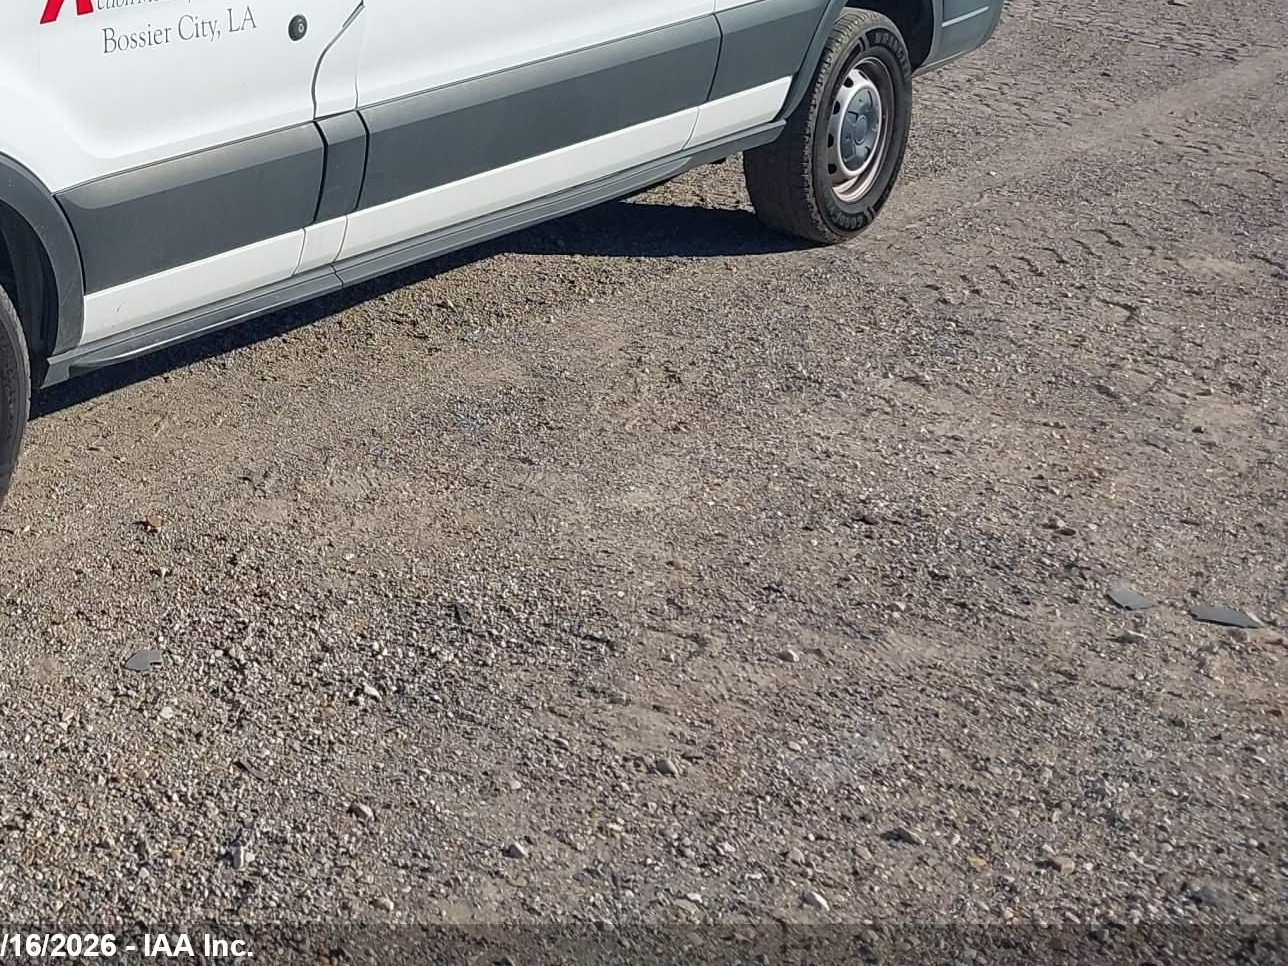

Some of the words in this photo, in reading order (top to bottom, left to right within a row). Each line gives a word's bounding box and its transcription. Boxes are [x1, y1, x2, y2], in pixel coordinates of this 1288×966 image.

[102, 23, 173, 54] Bossier
[178, 14, 222, 42] City,
[227, 5, 257, 34] LA
